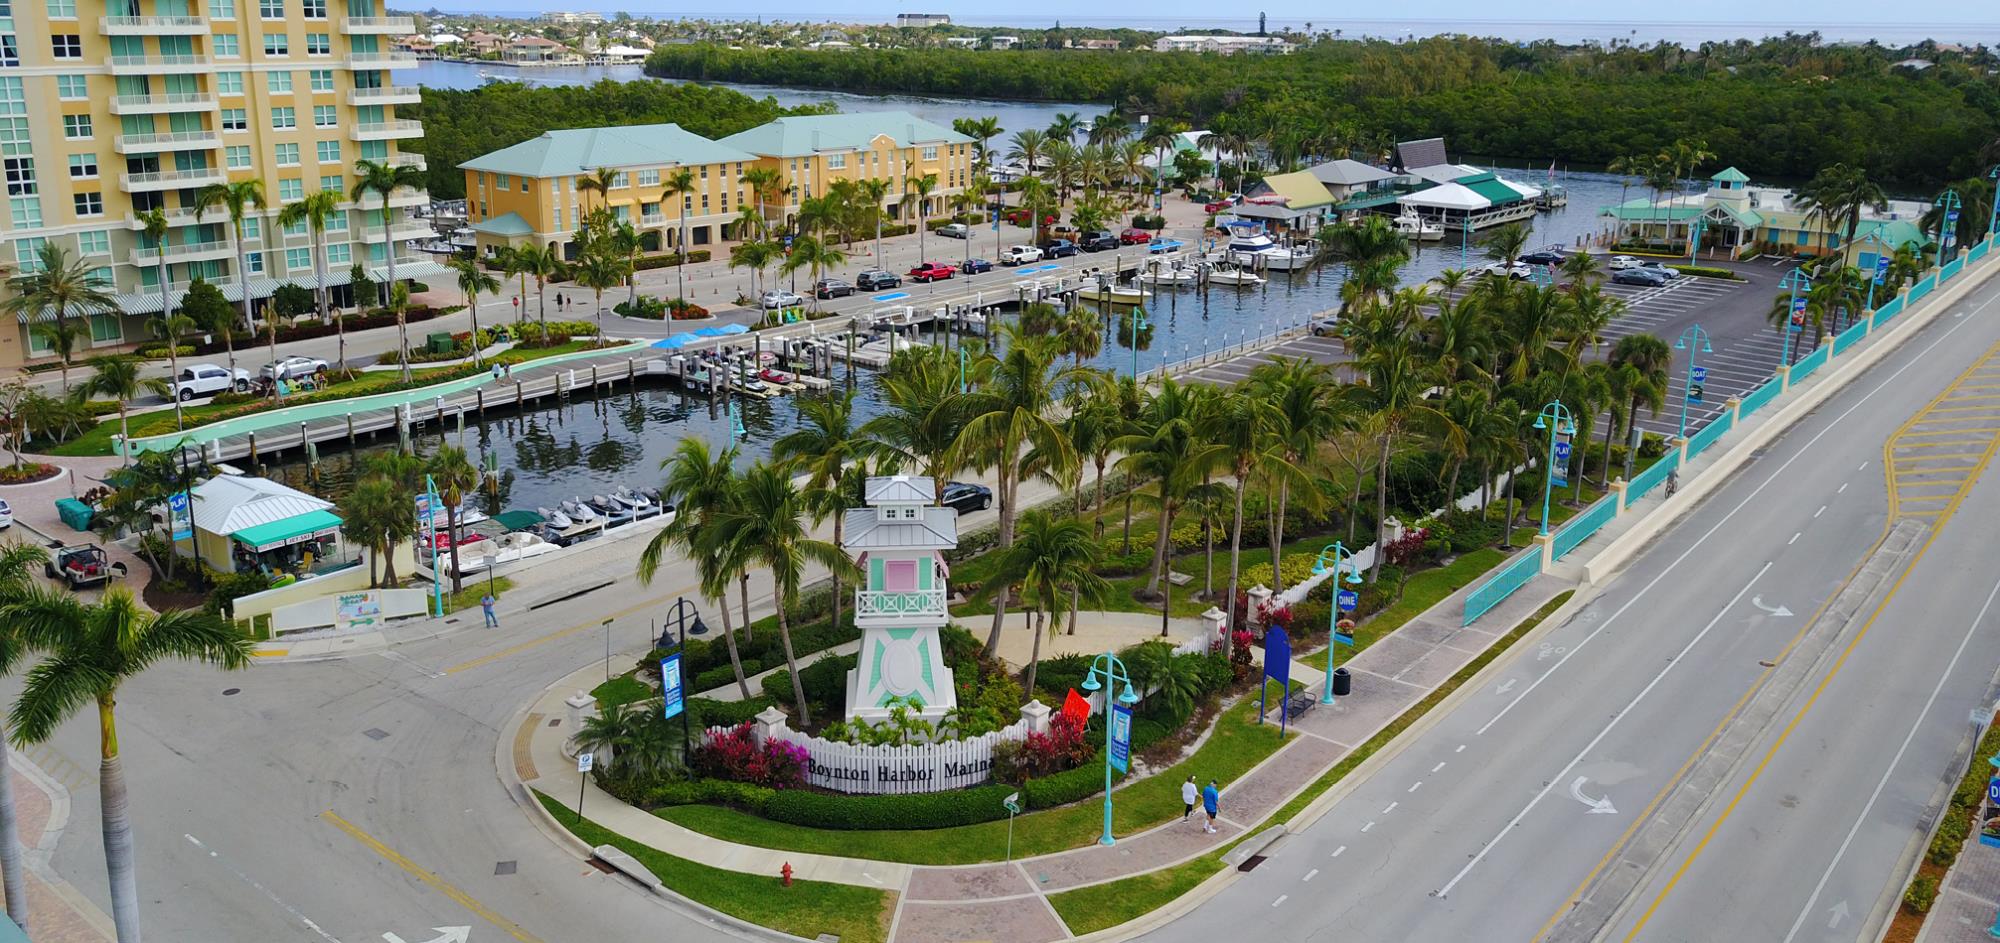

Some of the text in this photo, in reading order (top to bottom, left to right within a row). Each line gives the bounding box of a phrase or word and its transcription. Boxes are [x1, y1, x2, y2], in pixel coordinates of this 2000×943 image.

[1556, 446, 1568, 454] PLAY
[170, 497, 186, 508] PLAY
[1338, 595, 1356, 606] DINE
[808, 757, 995, 782] Boynton Harbor Marina
